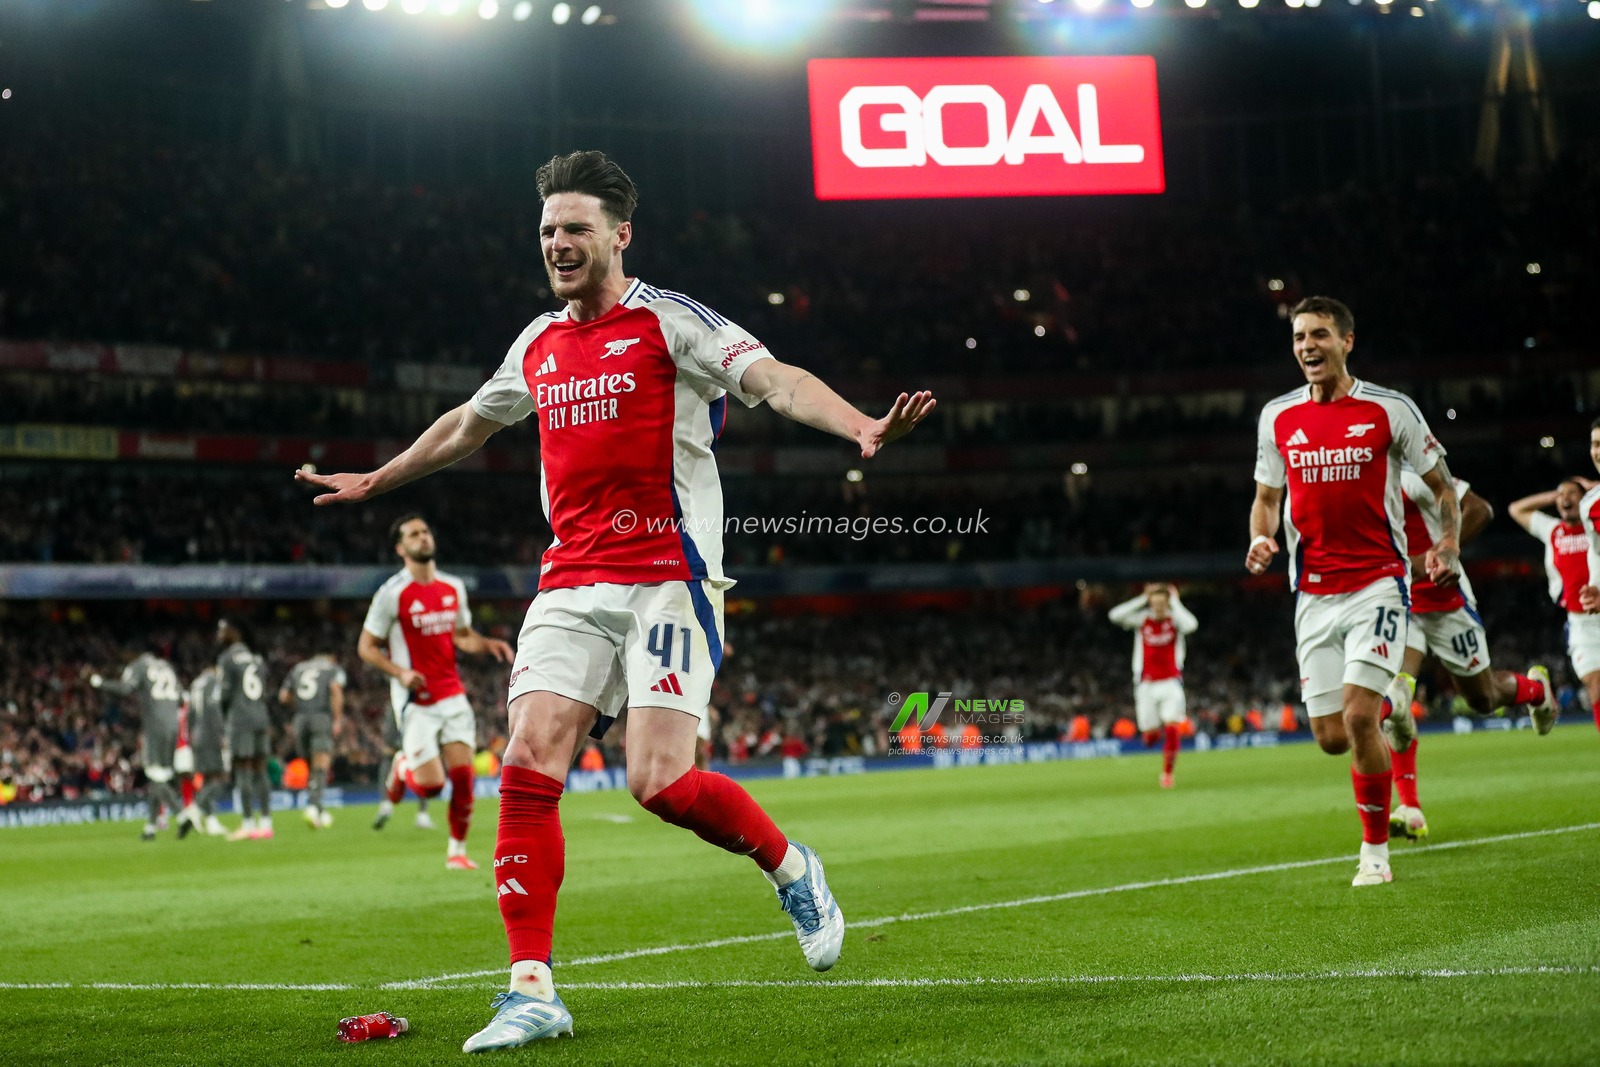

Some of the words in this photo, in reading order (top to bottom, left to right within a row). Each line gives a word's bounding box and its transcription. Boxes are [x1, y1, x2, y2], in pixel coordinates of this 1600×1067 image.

[839, 83, 1145, 168] GOAL
[721, 340, 749, 352] VISIT
[537, 371, 637, 409] Emirates
[549, 405, 567, 431] FLY
[571, 398, 619, 427] BETTER
[1288, 446, 1373, 469] Emirates
[1302, 467, 1318, 484] FLY
[1322, 464, 1361, 483] BETTER
[1374, 606, 1400, 643] 15
[647, 622, 692, 675] 41
[1452, 629, 1480, 659] 49
[147, 659, 179, 701] 22
[242, 662, 264, 701] 6
[297, 669, 321, 701] 5
[494, 854, 528, 868] AFC
